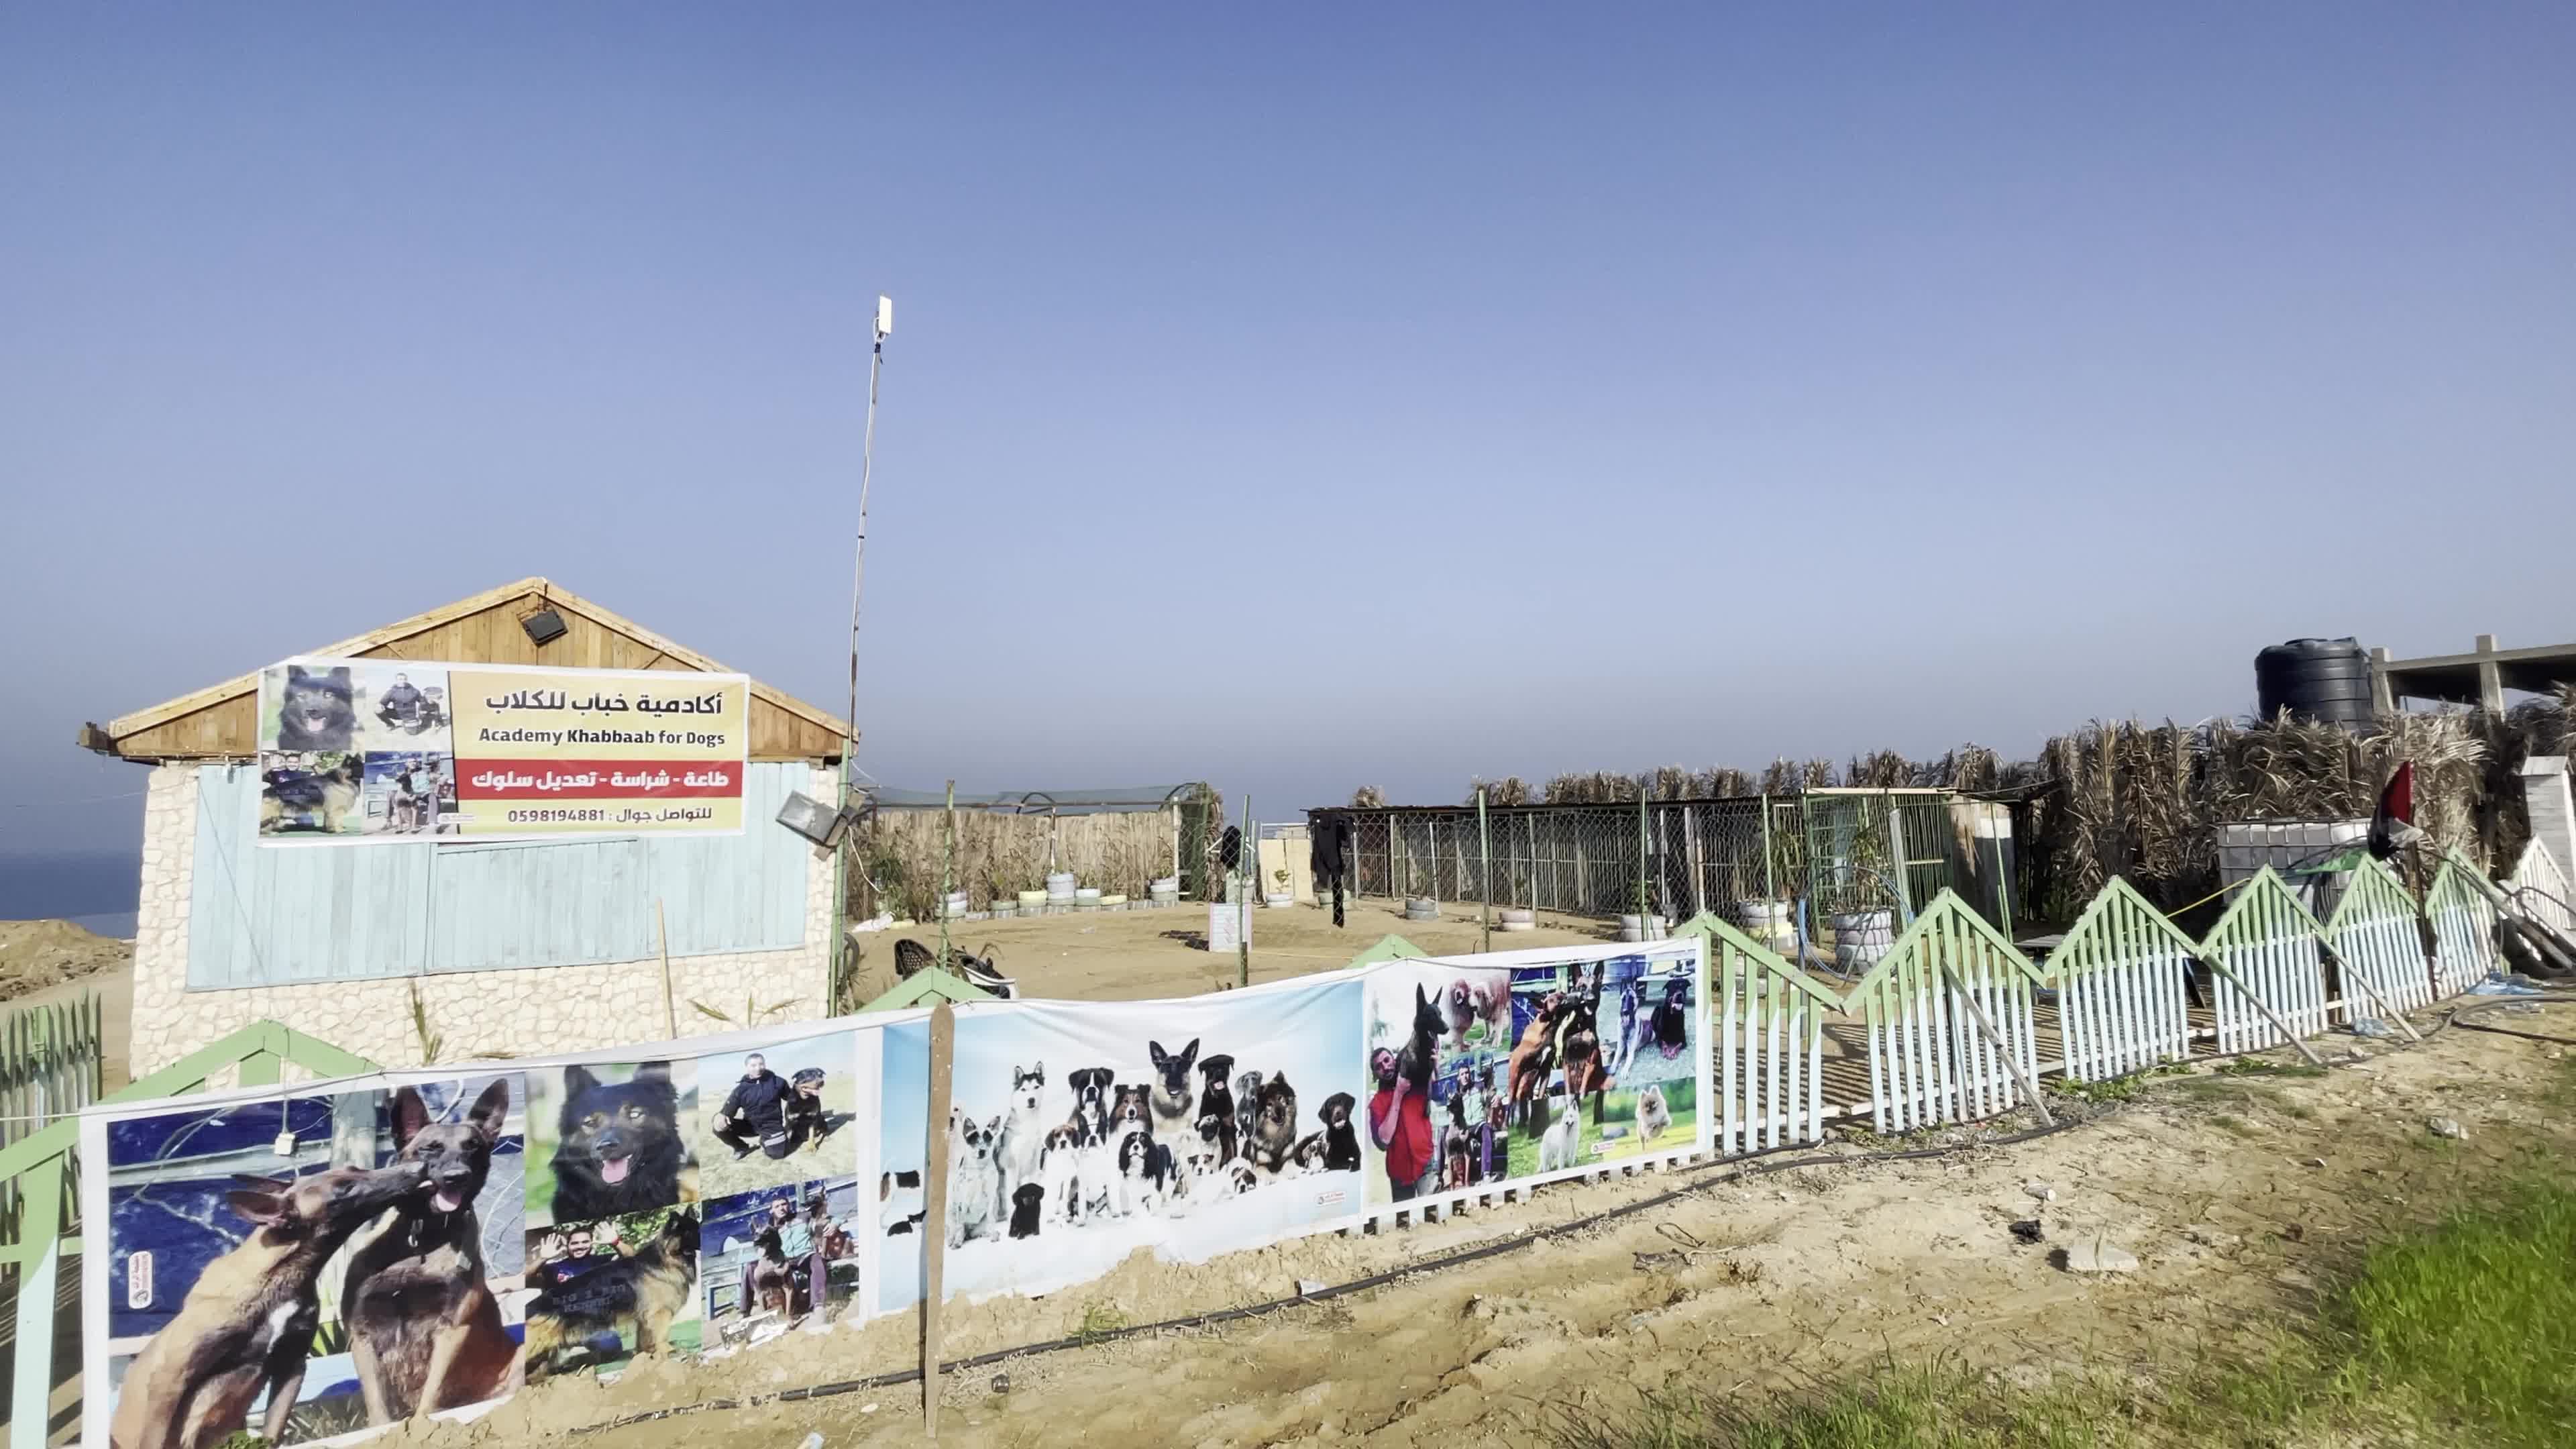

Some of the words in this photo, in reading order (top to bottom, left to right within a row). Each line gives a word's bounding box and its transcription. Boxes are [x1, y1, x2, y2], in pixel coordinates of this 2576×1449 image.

[486, 689, 566, 714] للكلاب
[572, 692, 629, 716] خباب
[637, 692, 722, 717] أكادمية
[479, 728, 563, 746] Academy
[567, 729, 655, 743] Khabbaab
[659, 730, 682, 744] for
[686, 732, 725, 748] Dogs
[472, 770, 533, 792] سلوك
[536, 771, 598, 791] تعديل
[610, 769, 669, 790] شراسة
[683, 771, 729, 787] طاعة
[508, 809, 604, 822] 0598194881
[616, 808, 651, 824] جوال
[656, 808, 712, 822] للتواصل
